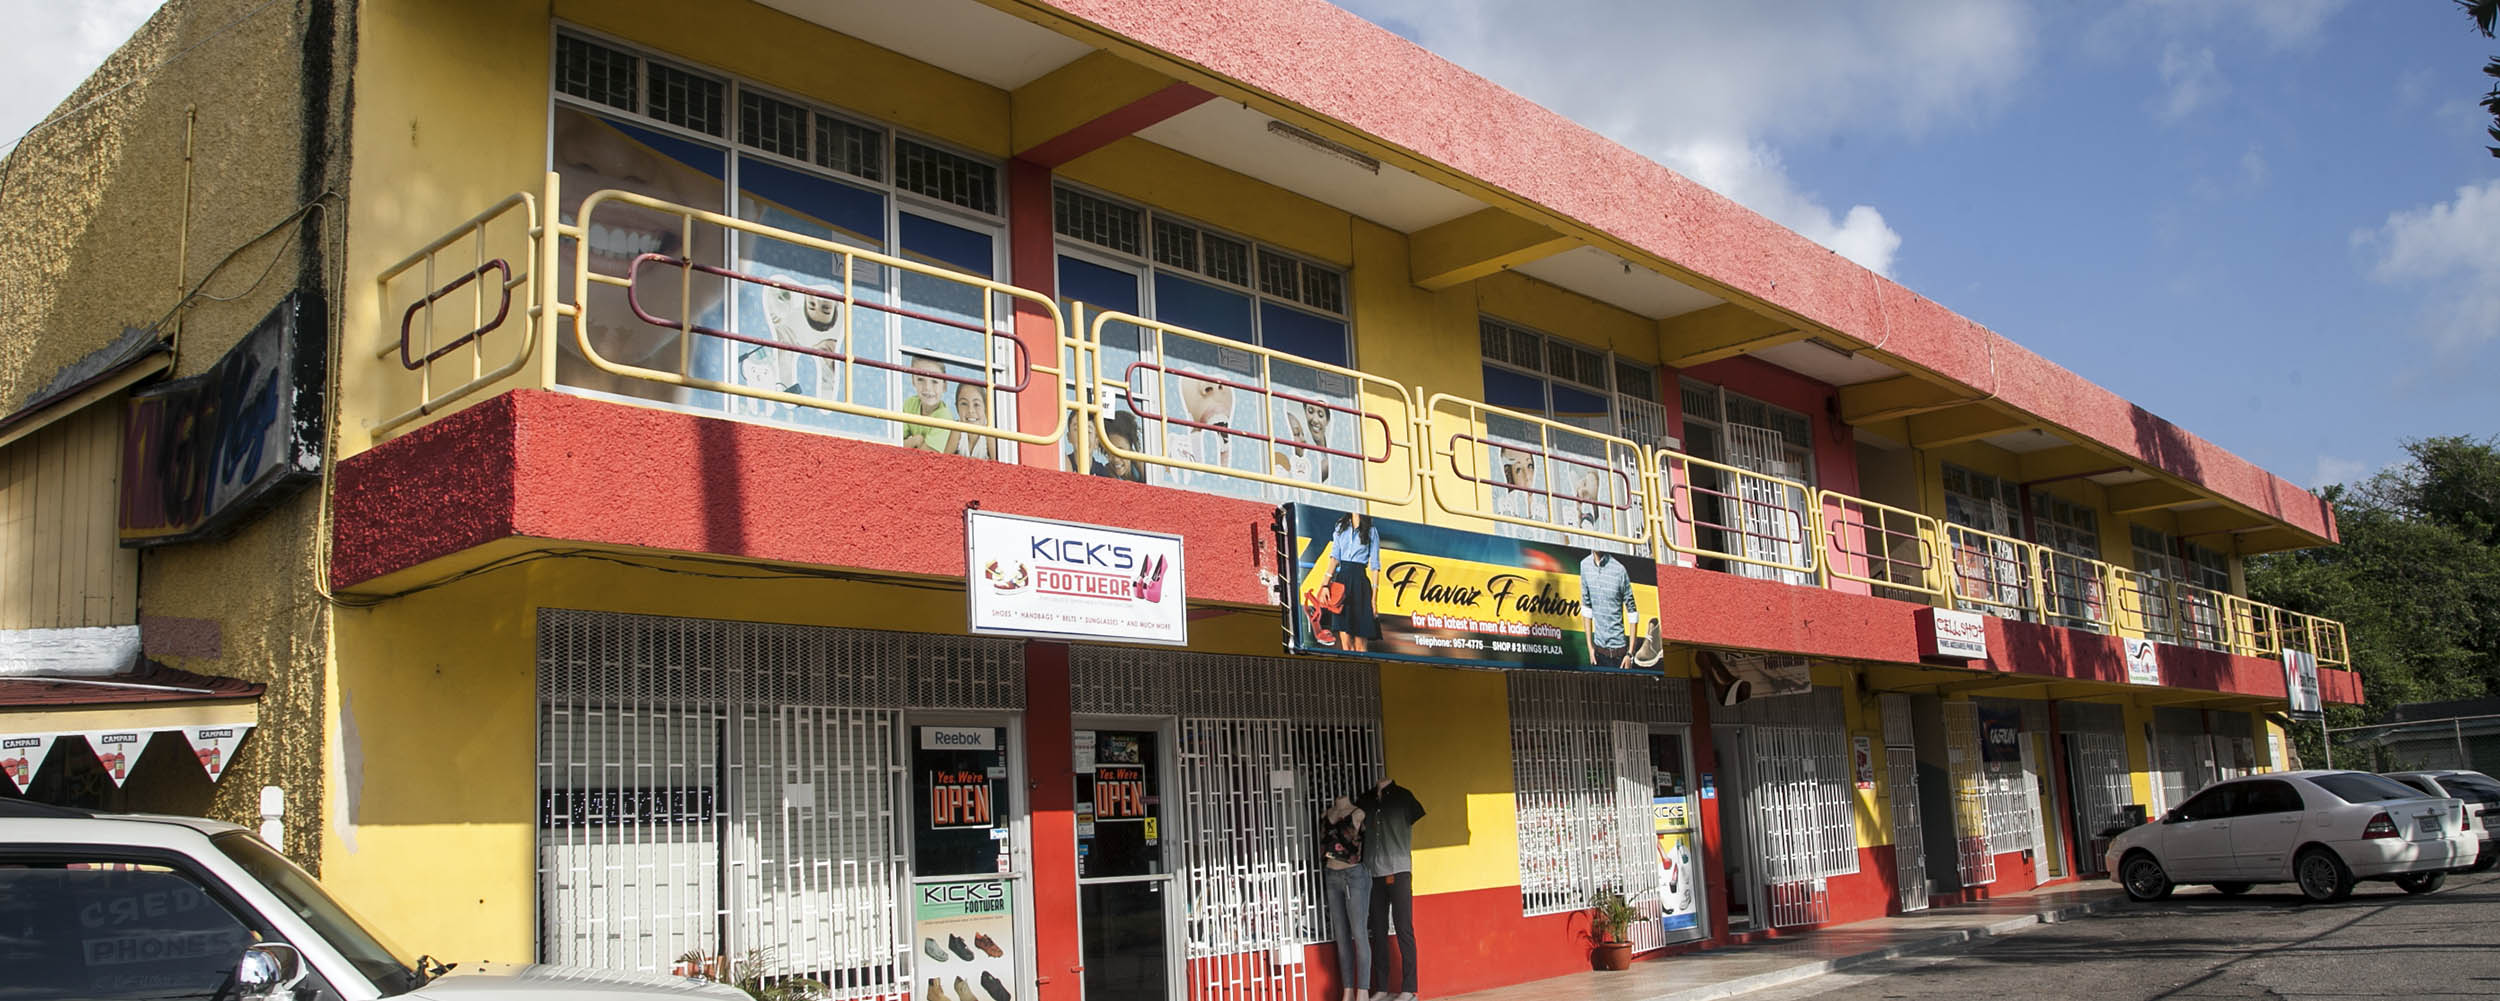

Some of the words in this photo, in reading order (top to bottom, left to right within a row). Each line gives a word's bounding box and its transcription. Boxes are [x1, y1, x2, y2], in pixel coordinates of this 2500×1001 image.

[1031, 536, 1133, 569] KICK'S
[1036, 571, 1130, 596] FOOTWEAR
[1386, 561, 1482, 608] Flavaz
[1487, 574, 1581, 617] Fashion
[992, 609, 1012, 617] SHOES
[1021, 612, 1053, 621] HANDBAGS
[1062, 615, 1077, 623] BELTS
[1085, 616, 1118, 626] SUNGLASSES
[1412, 611, 1426, 626] for
[1427, 613, 1442, 628] the
[1443, 616, 1468, 630] latest
[1469, 618, 1478, 631] in
[1479, 621, 1498, 633] men
[1499, 621, 1507, 633] &
[1507, 621, 1530, 636] ladies
[1531, 624, 1561, 639] clothing
[1937, 618, 1961, 637] CELL
[1960, 622, 1984, 641] SHOP
[1414, 635, 1453, 649] Telephone:
[1453, 639, 1484, 651] 957-4775
[1492, 641, 1511, 652] SHOP
[1522, 643, 1542, 654] KINGS
[1543, 645, 1563, 656] PLAZA
[4, 739, 39, 748] CAMPARI
[103, 734, 136, 743] CAMPARI
[200, 730, 232, 739] CAMPARI
[935, 732, 981, 745] Reebok
[957, 770, 983, 784] We're
[933, 785, 990, 824] OPEN
[1096, 781, 1144, 817] OPEN
[924, 882, 1003, 904] KICK'S
[964, 898, 1005, 914] FOOTWEAR
